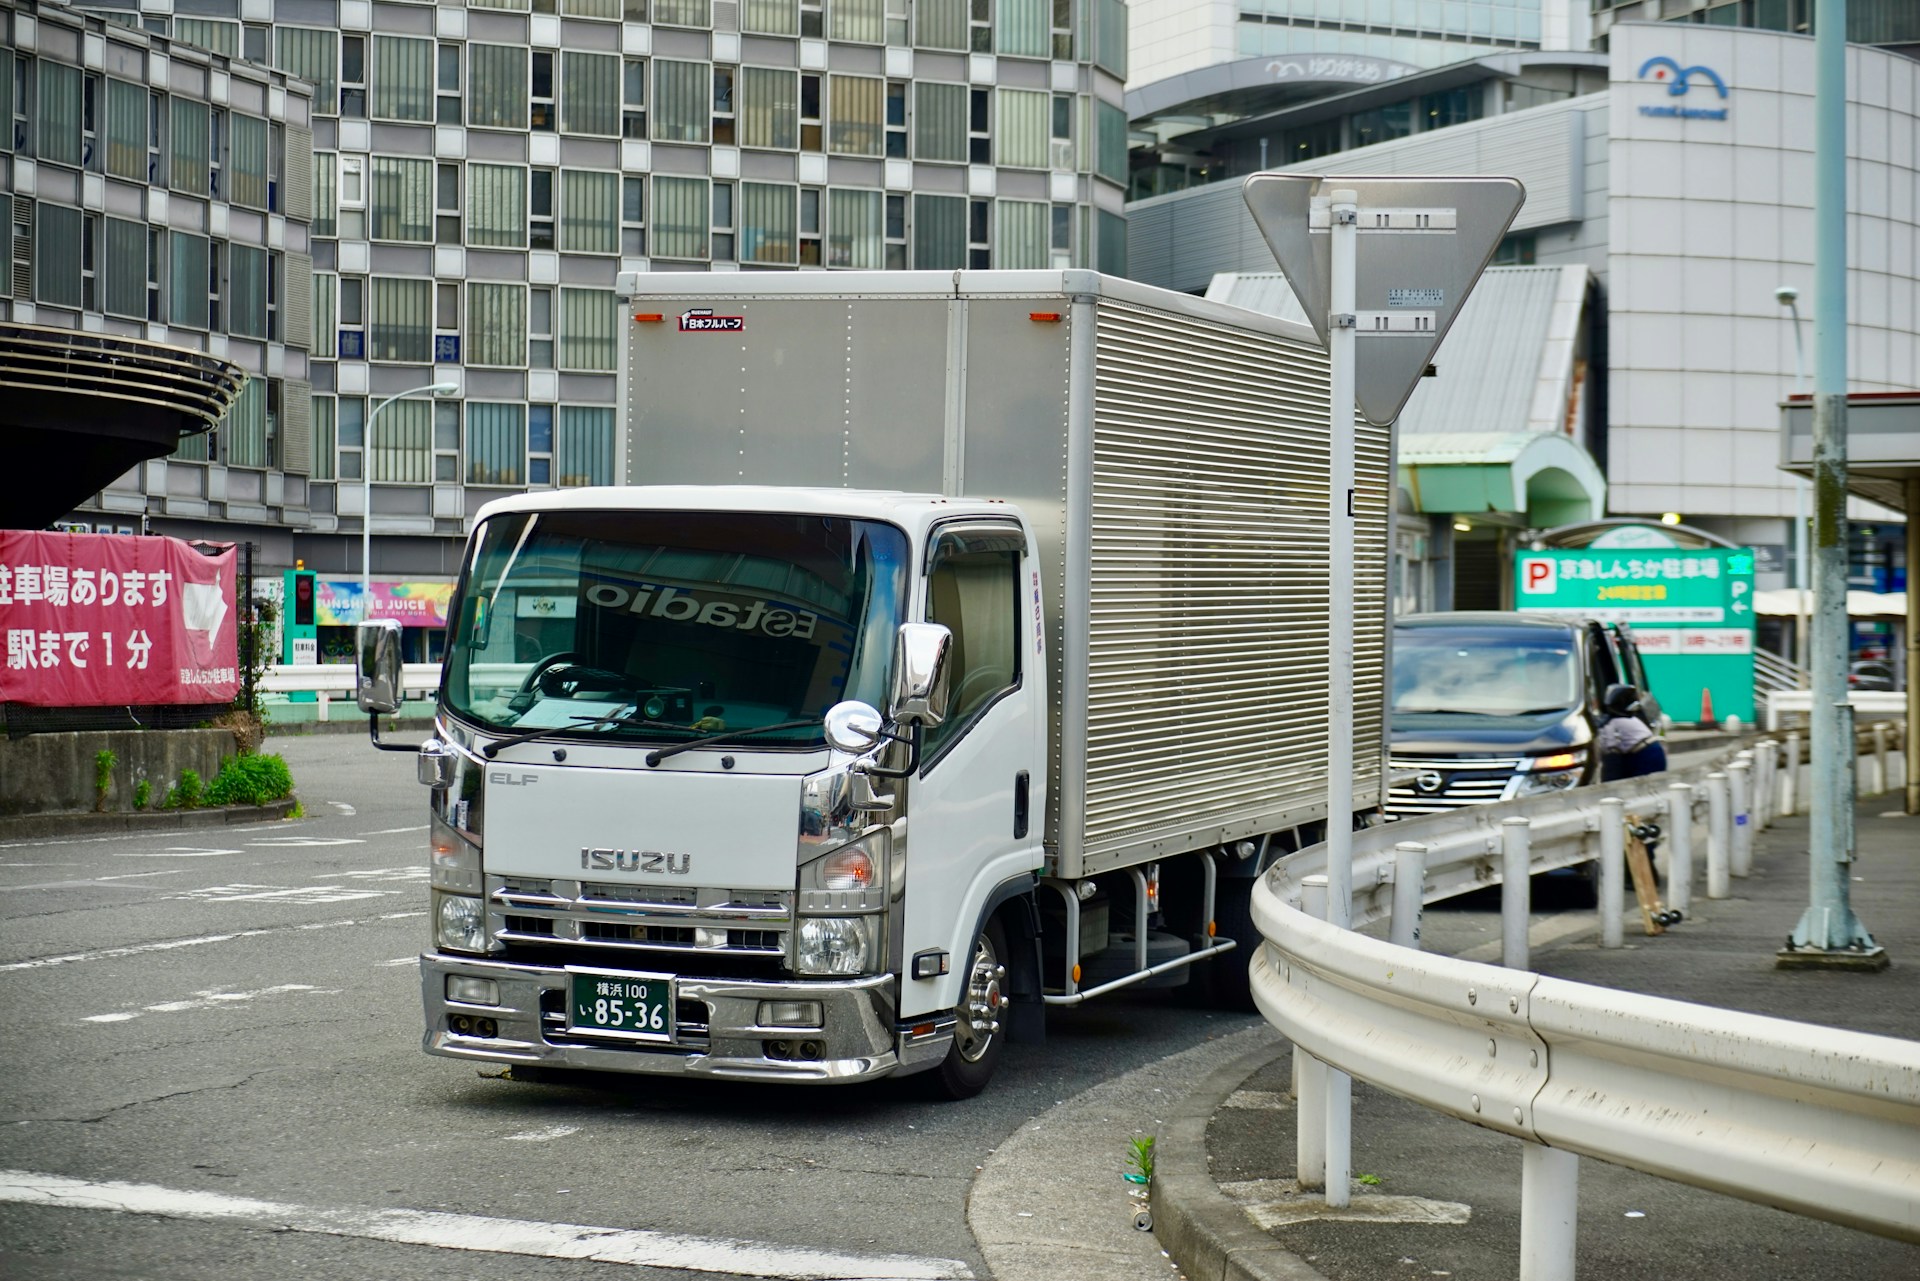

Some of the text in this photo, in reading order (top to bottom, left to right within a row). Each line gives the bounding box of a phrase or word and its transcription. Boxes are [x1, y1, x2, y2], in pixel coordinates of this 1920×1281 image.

[689, 319, 742, 329] 日本フルハーフ
[1528, 563, 1549, 588] P
[1732, 581, 1748, 598] P
[387, 600, 426, 610] JUICE
[489, 772, 539, 786] ELF
[581, 847, 690, 874] ISUZU
[596, 982, 647, 999] 横浜 100
[579, 999, 663, 1029] い 85-36
